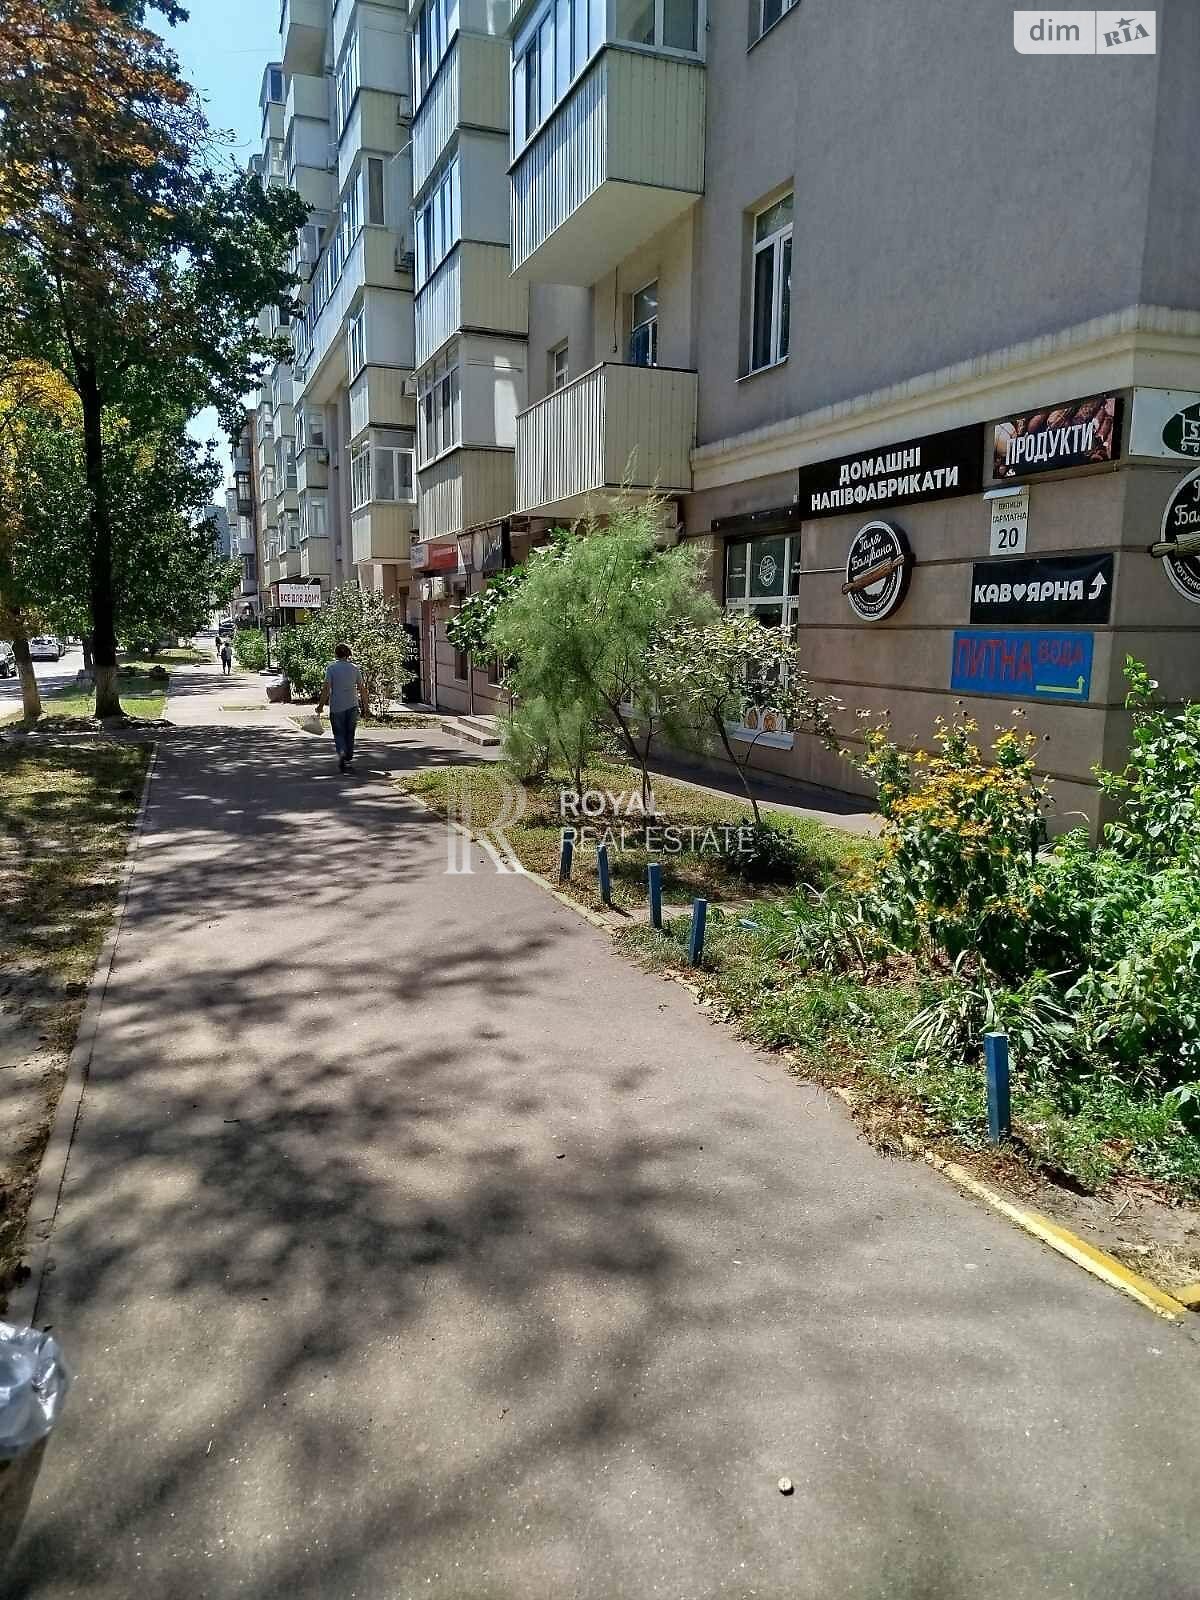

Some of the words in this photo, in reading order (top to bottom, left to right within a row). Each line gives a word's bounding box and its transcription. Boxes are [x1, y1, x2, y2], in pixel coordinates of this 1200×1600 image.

[1005, 422, 1094, 465] ПРОДУКТИ
[839, 446, 921, 486] ДОМАШНІ
[811, 465, 959, 511] НАПІВФАБРИКАТИ
[998, 527, 1019, 549] 20
[955, 639, 1033, 681] ПИТНА
[1037, 639, 1084, 667] ВОДА
